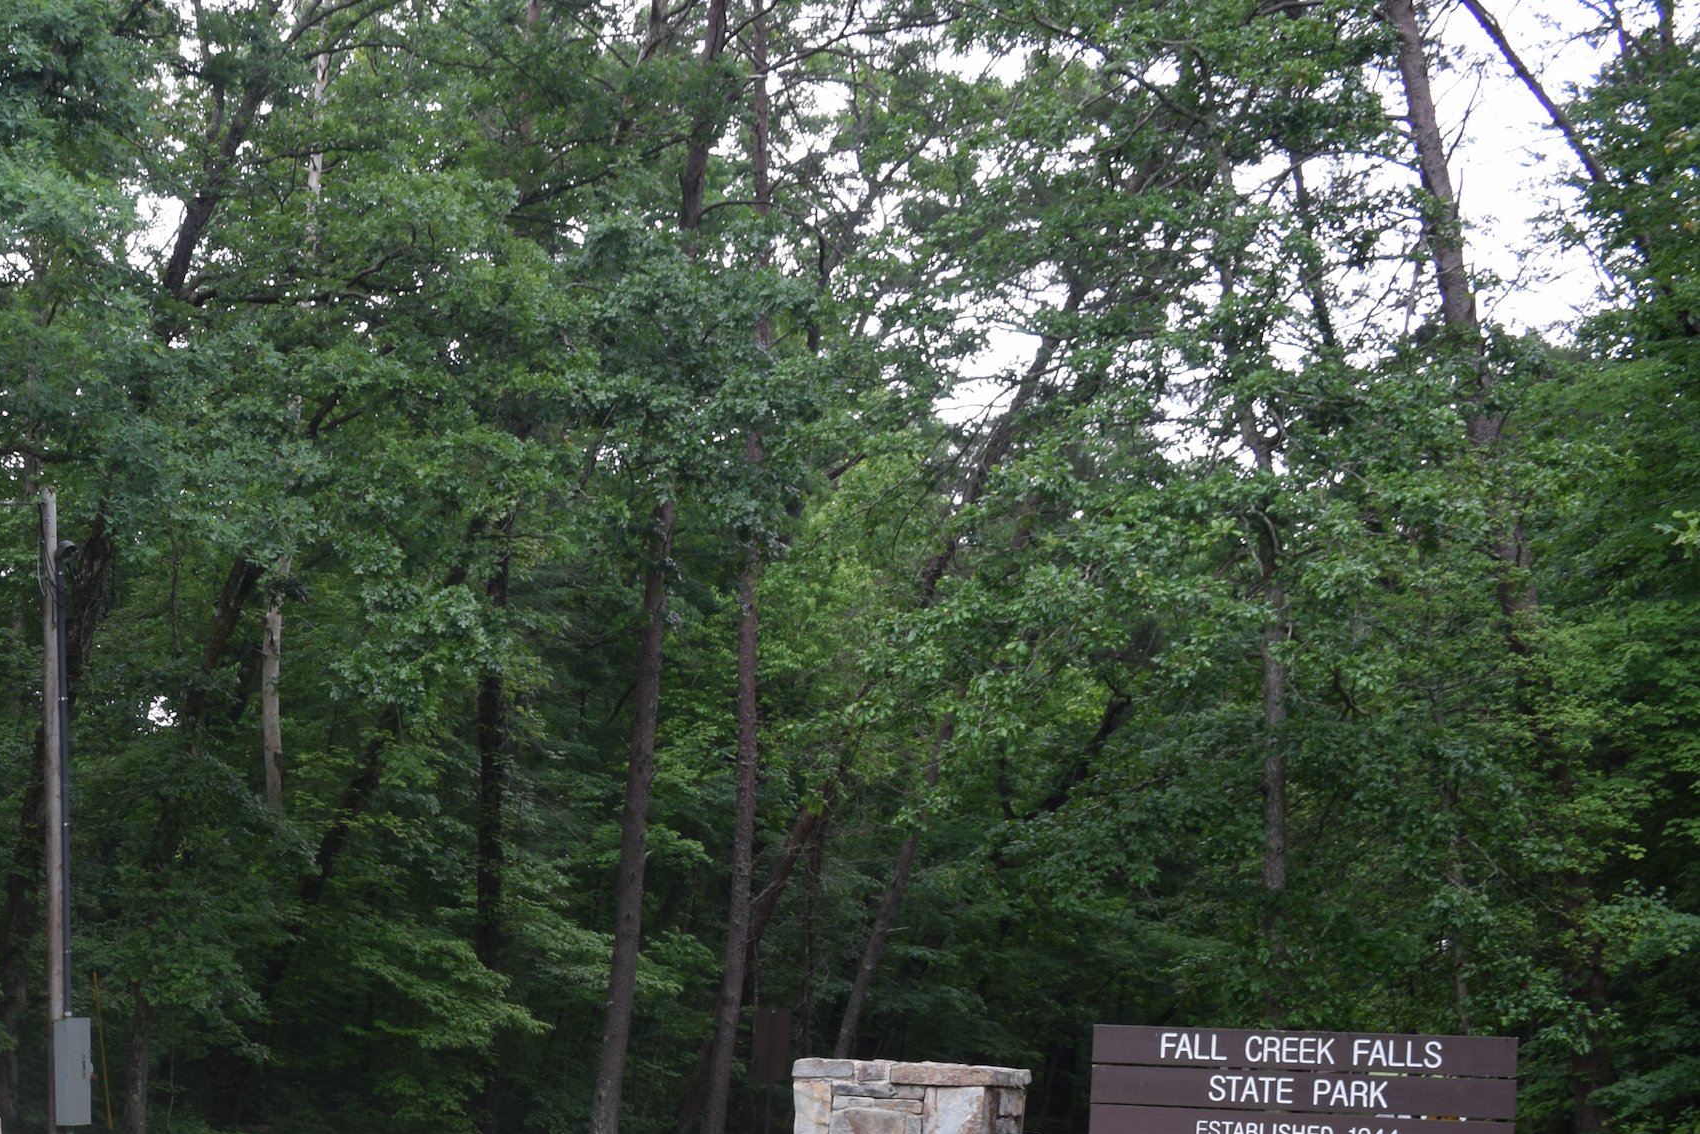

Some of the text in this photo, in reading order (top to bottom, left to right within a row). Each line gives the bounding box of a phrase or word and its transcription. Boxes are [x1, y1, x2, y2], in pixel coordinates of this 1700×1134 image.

[1159, 1032, 1443, 1069] FALL CREEK FALLS
[1208, 1074, 1388, 1109] STATE PARK
